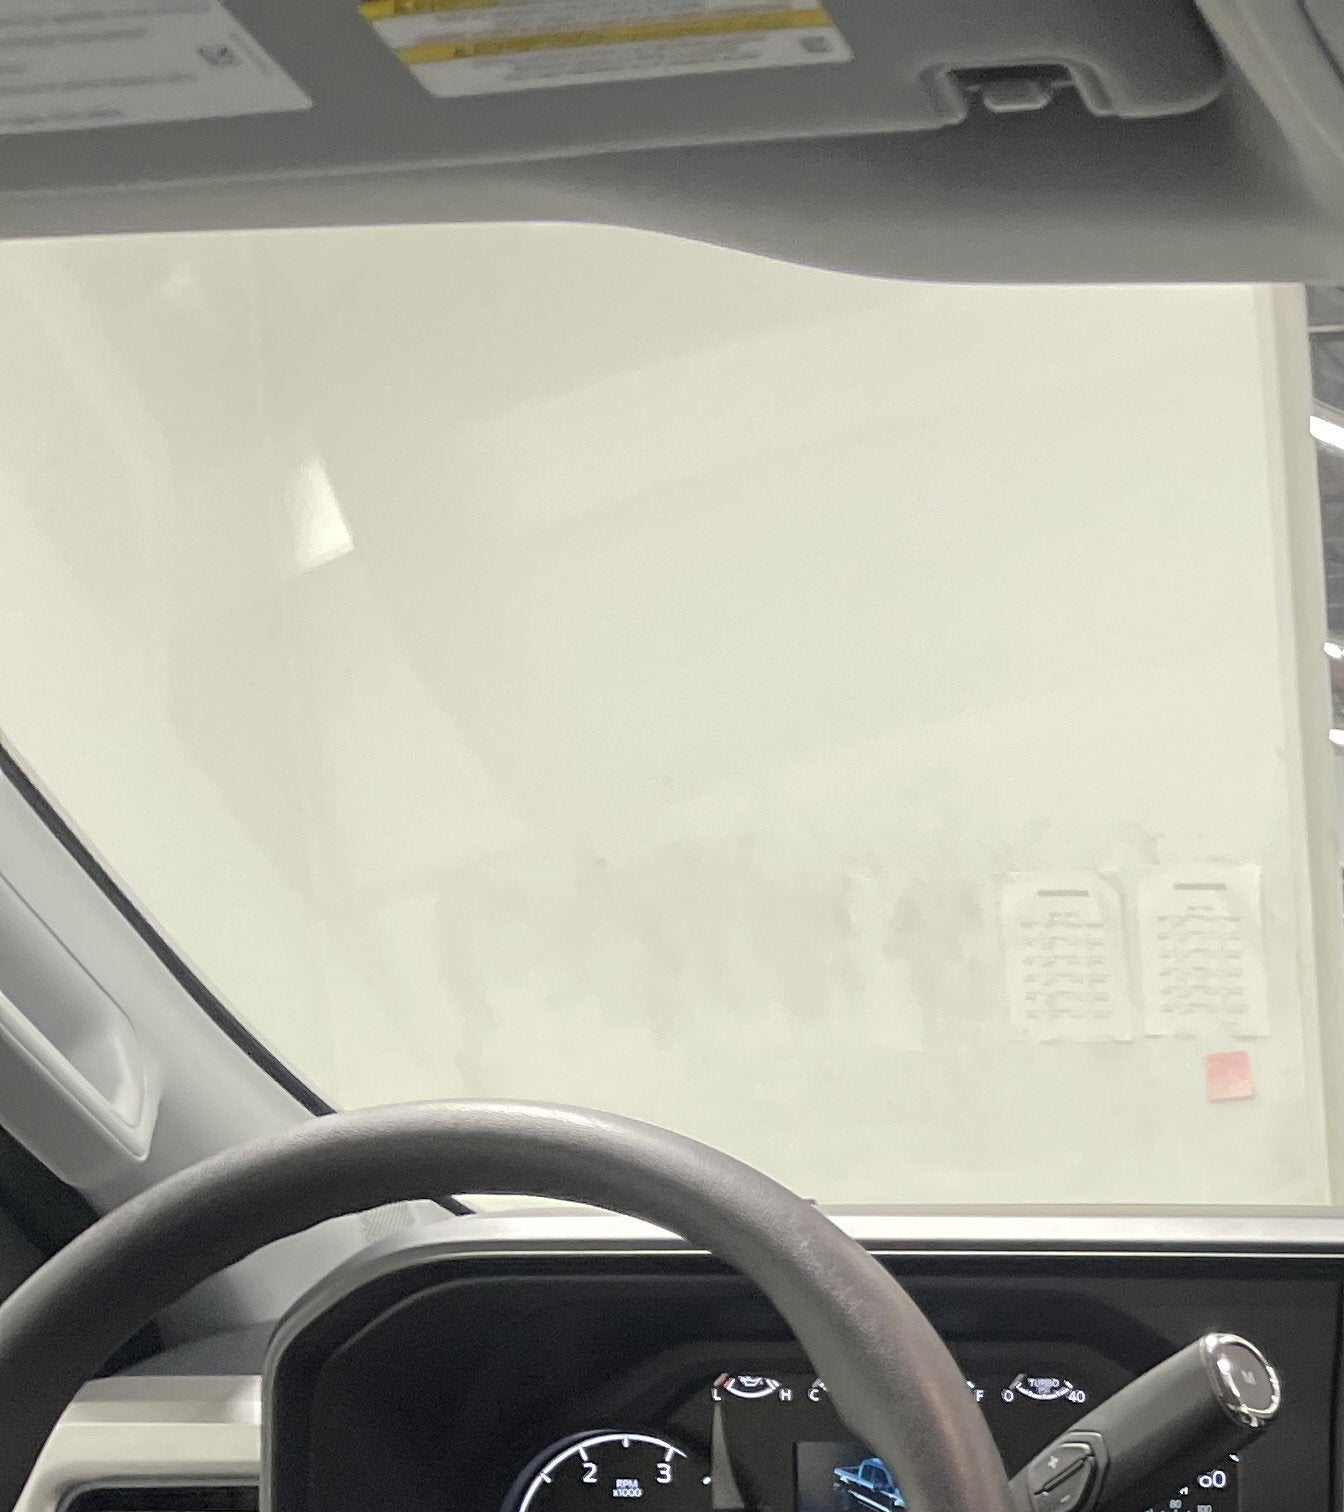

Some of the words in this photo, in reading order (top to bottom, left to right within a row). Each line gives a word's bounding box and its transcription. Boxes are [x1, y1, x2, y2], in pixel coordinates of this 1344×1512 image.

[778, 1388, 793, 1401] H
[1067, 1390, 1086, 1403] 40
[582, 1462, 598, 1483] 2
[656, 1462, 672, 1483] 3
[616, 1478, 639, 1488] RPM
